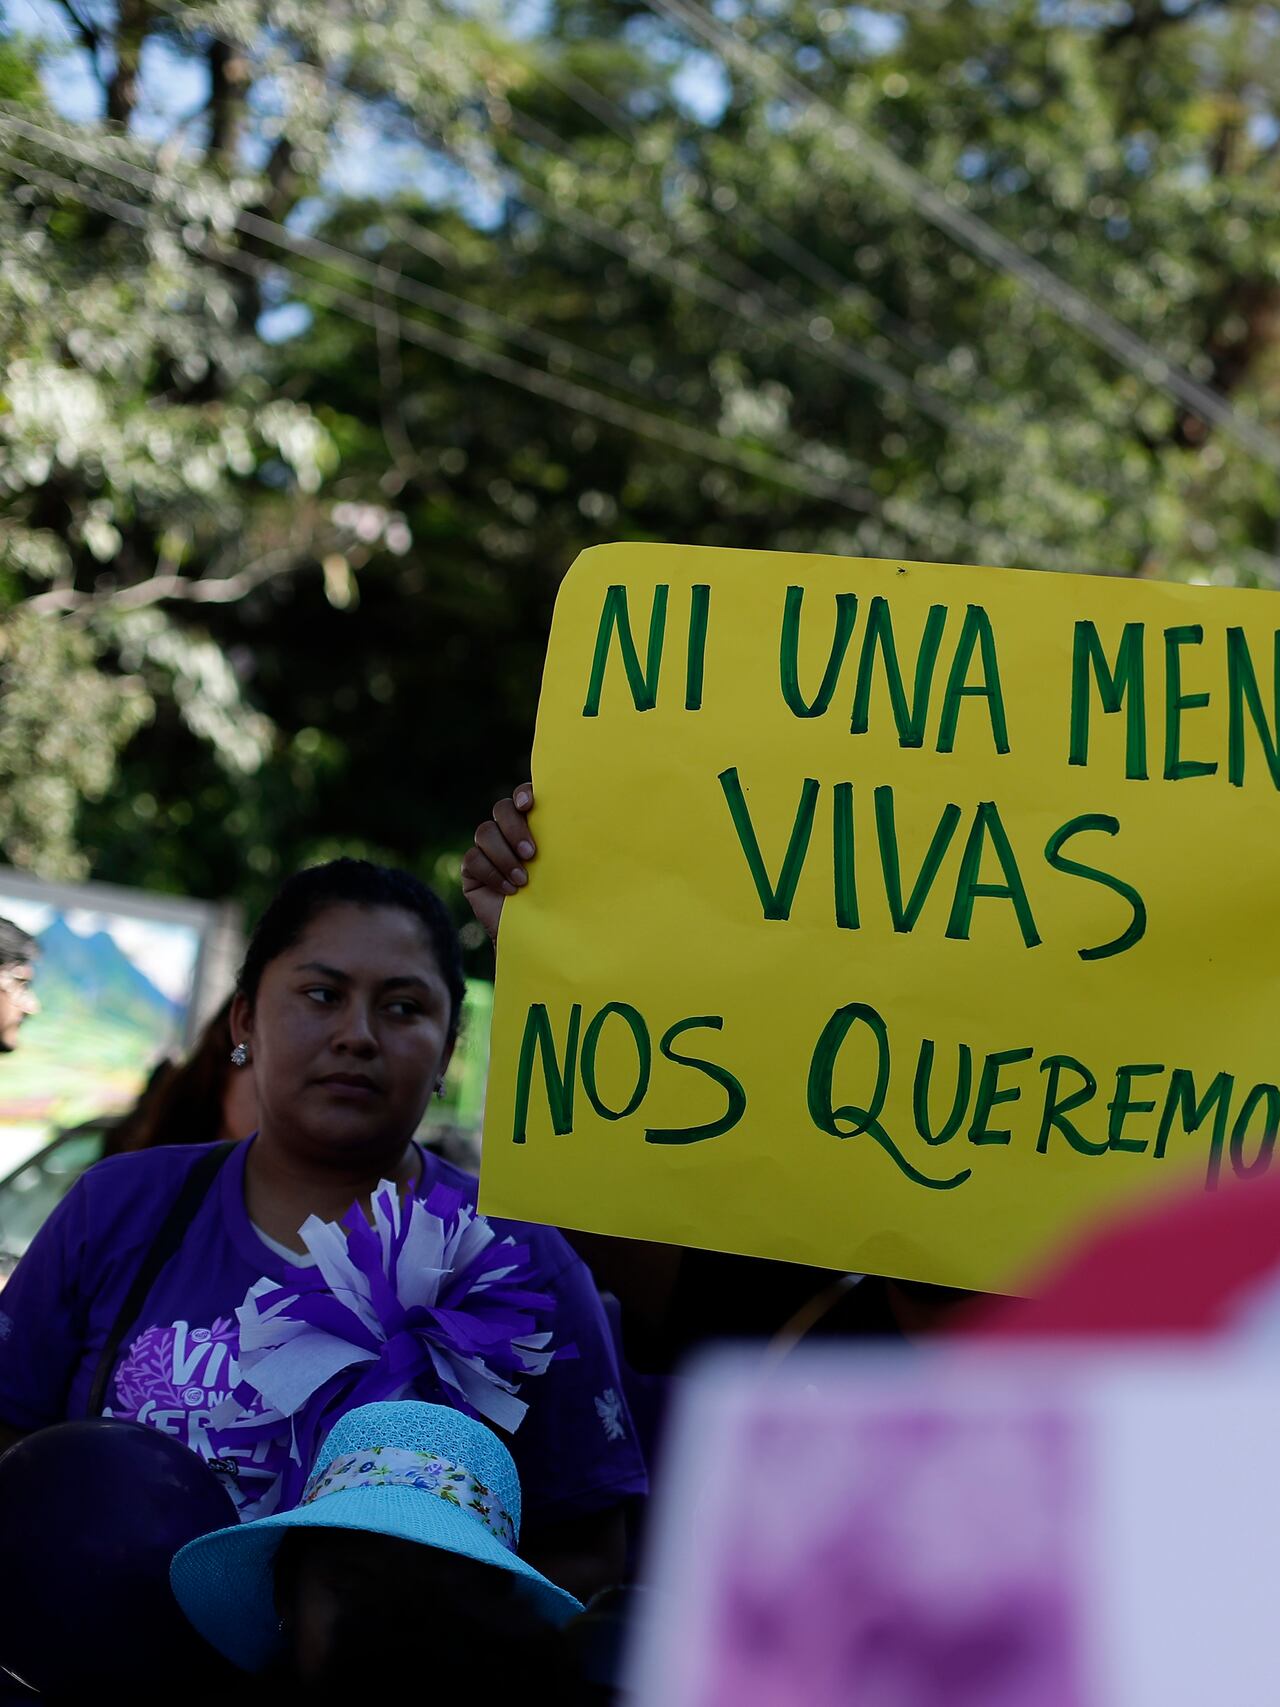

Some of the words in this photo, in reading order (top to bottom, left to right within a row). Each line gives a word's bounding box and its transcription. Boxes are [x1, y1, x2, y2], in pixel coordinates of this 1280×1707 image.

[582, 584, 710, 718] NI
[779, 585, 1011, 754] UNA
[717, 767, 1147, 961] VIVAS
[512, 1002, 747, 1145] NOS
